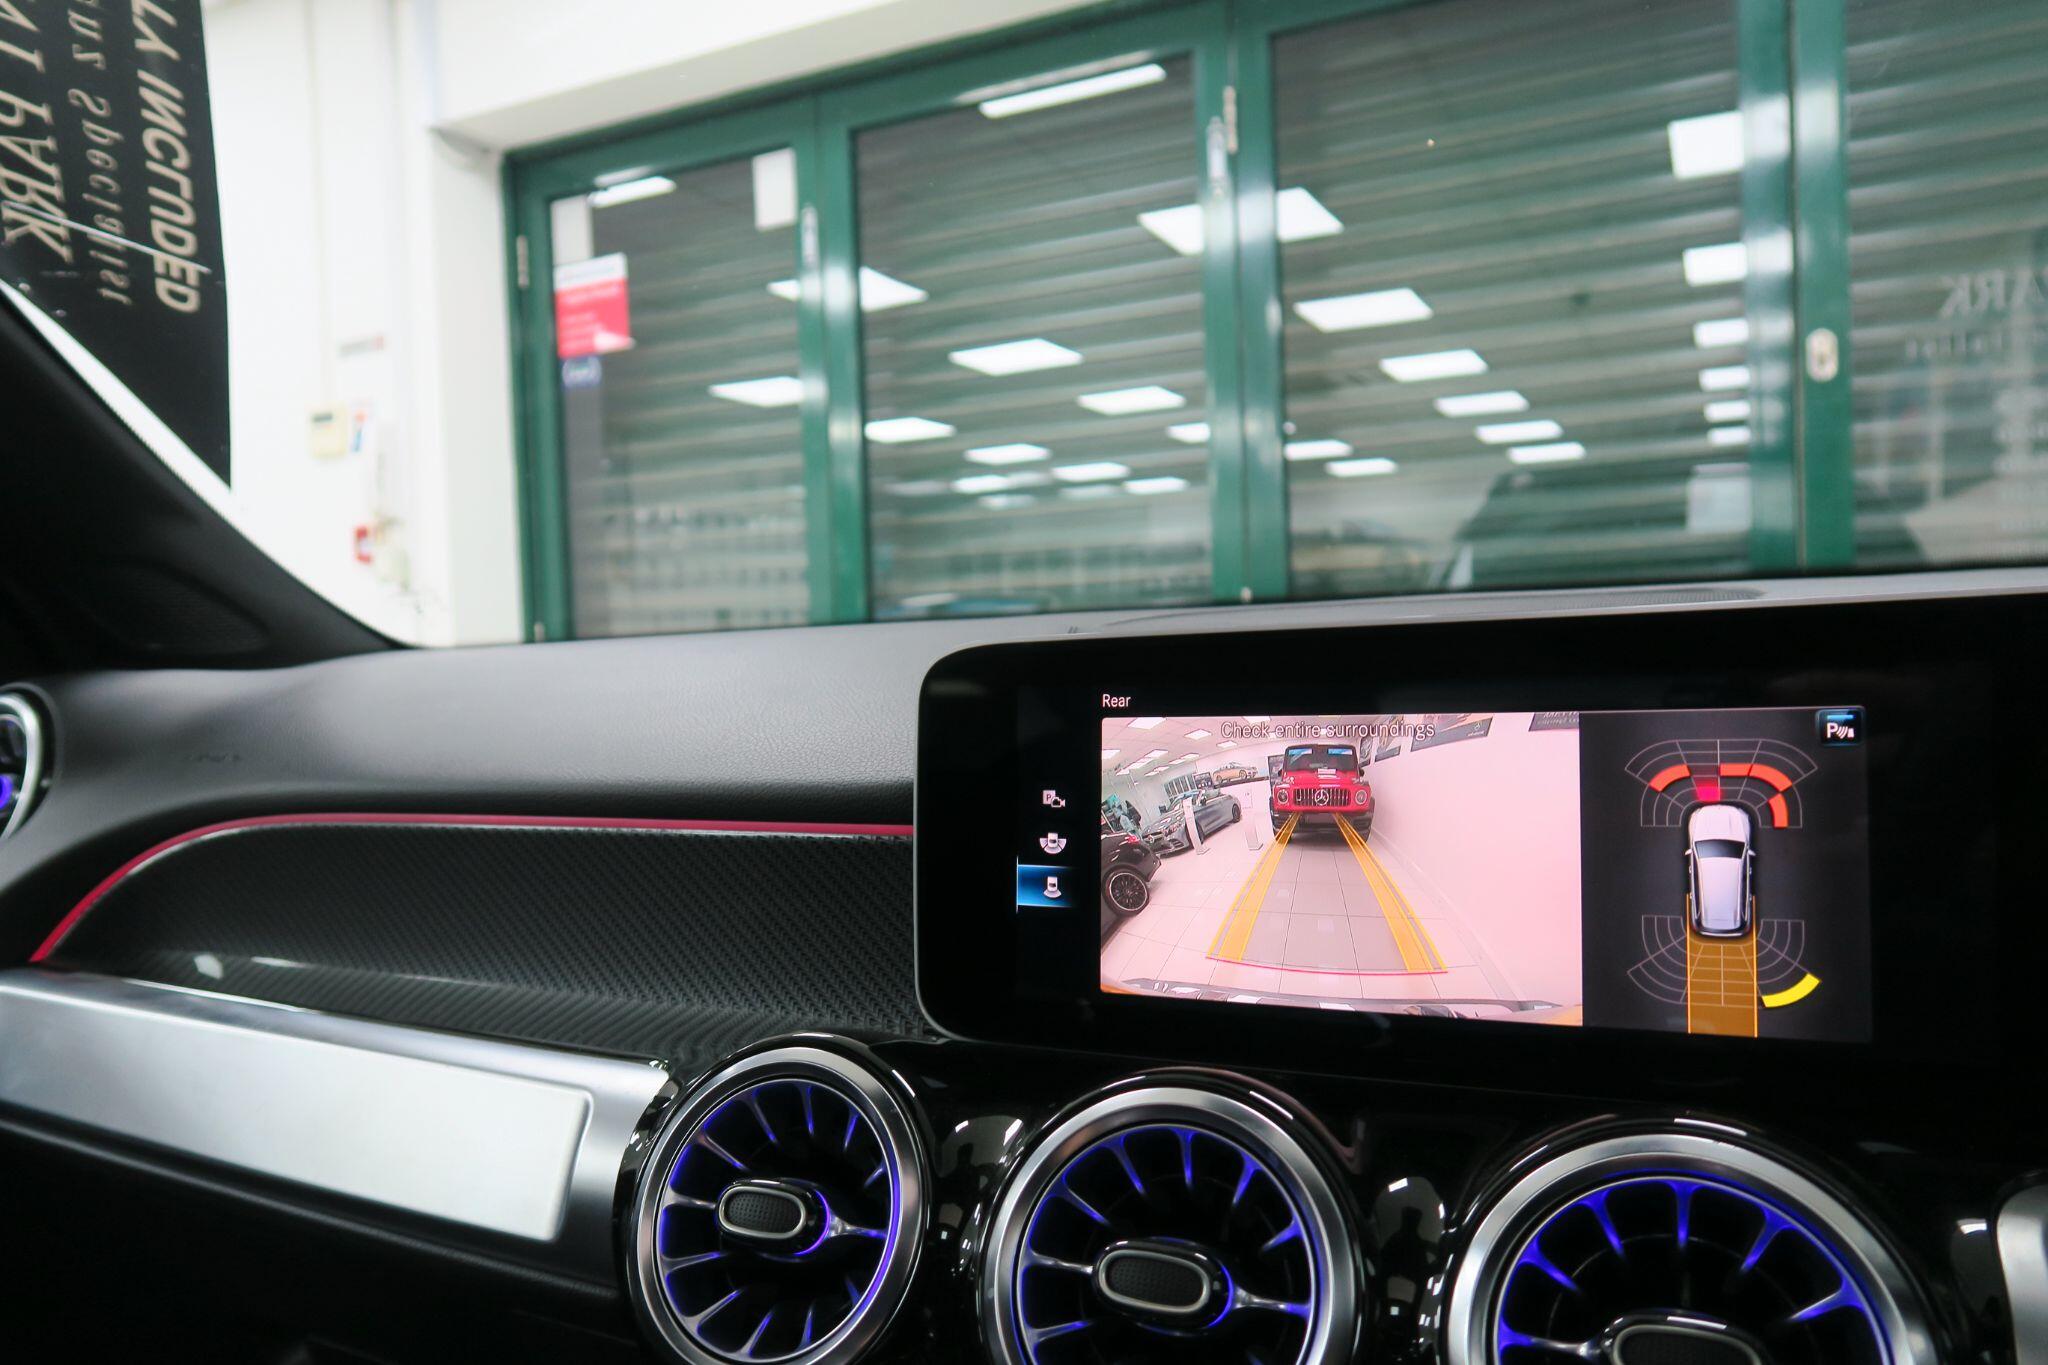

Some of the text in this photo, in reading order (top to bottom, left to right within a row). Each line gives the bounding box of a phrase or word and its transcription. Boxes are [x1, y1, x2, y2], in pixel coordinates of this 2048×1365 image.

[1102, 693, 1131, 708] Rear
[1221, 721, 1435, 741] Check entire surroundings
